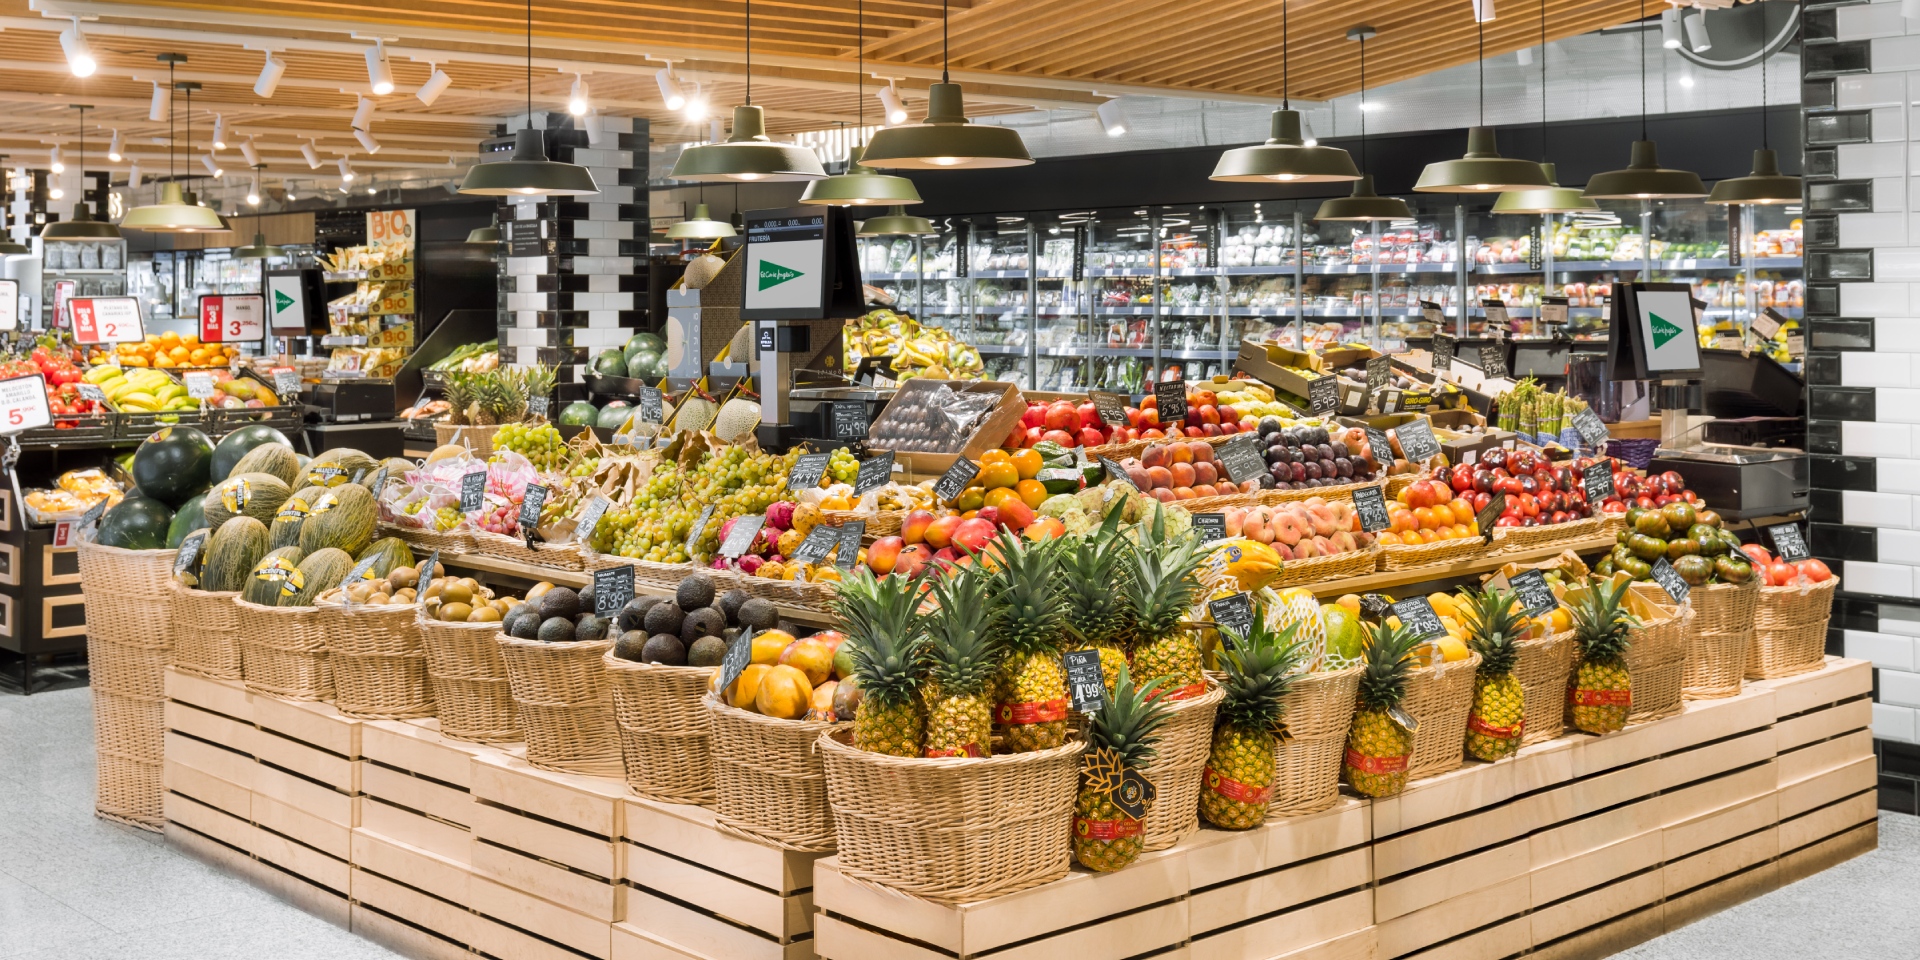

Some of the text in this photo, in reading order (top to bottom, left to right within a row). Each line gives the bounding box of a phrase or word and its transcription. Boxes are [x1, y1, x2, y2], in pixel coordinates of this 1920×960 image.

[748, 233, 771, 243] FRUTERÍA
[209, 310, 217, 323] 3
[1405, 396, 1432, 405] GIRO-GIRO
[597, 592, 625, 611] 8'99
